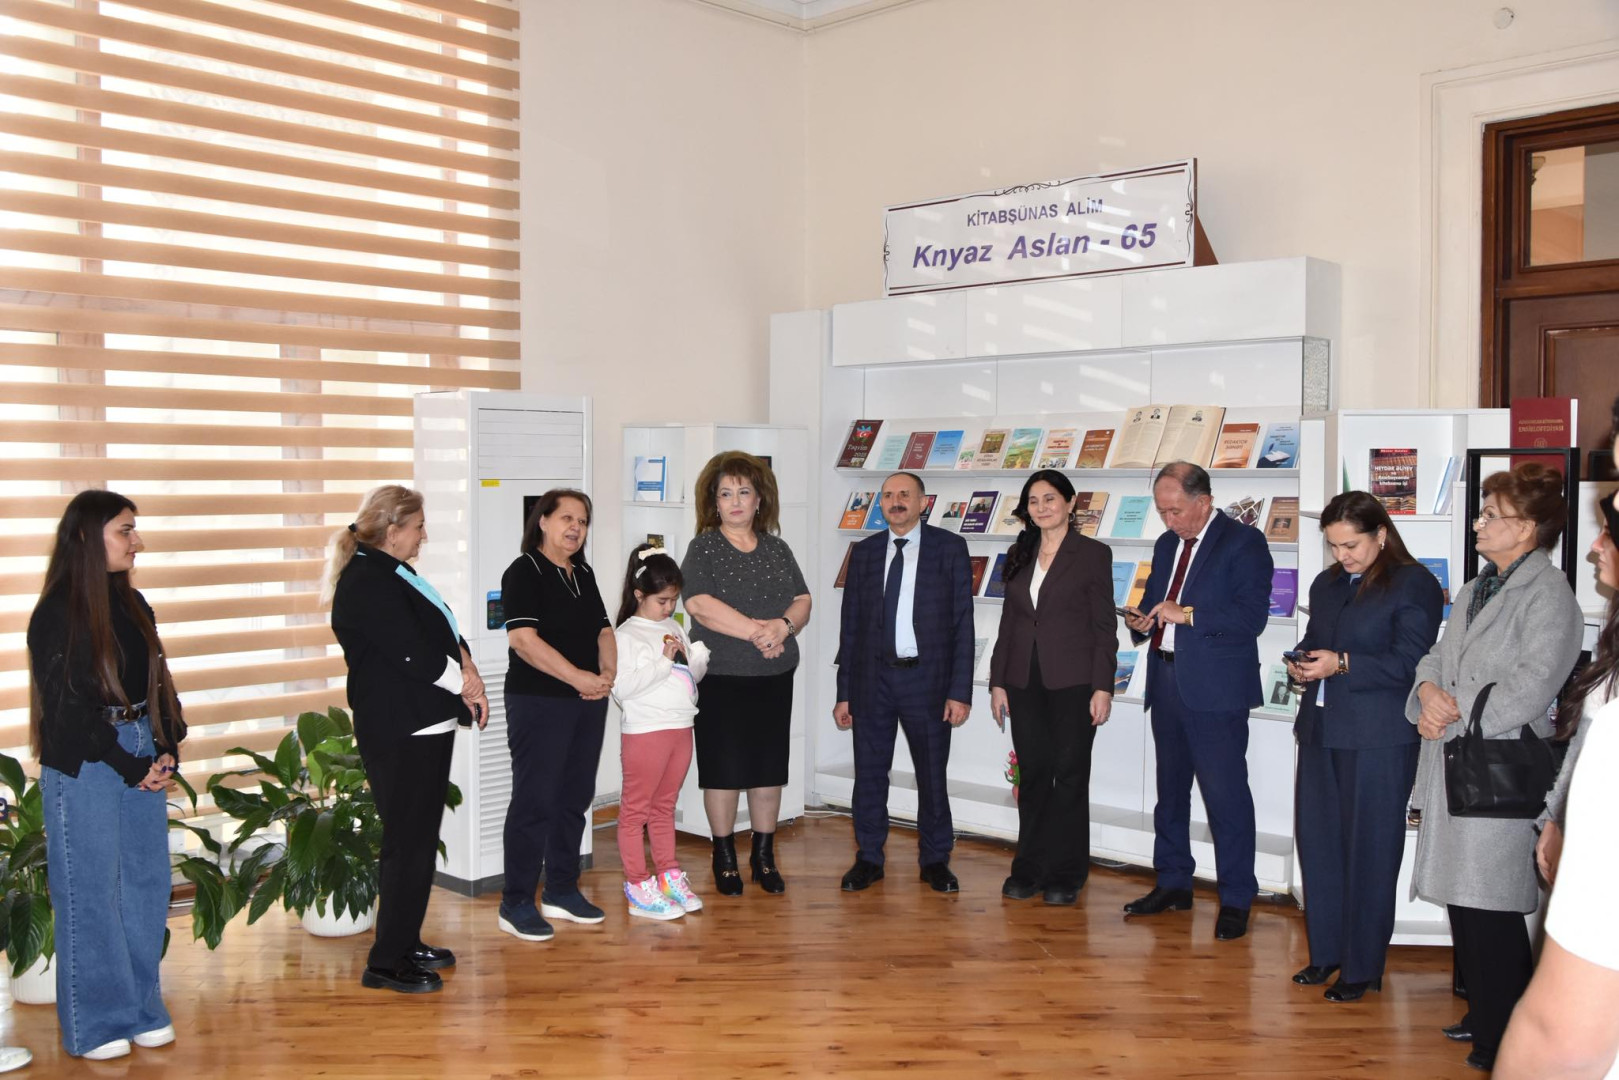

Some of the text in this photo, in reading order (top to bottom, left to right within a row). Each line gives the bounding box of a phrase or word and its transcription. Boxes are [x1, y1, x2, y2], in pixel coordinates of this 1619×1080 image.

[966, 197, 1103, 227] KİTABŞÜNAS ALİM
[912, 243, 993, 271] Knyaz
[1008, 232, 1091, 260] Aslan
[1120, 222, 1157, 250] 65
